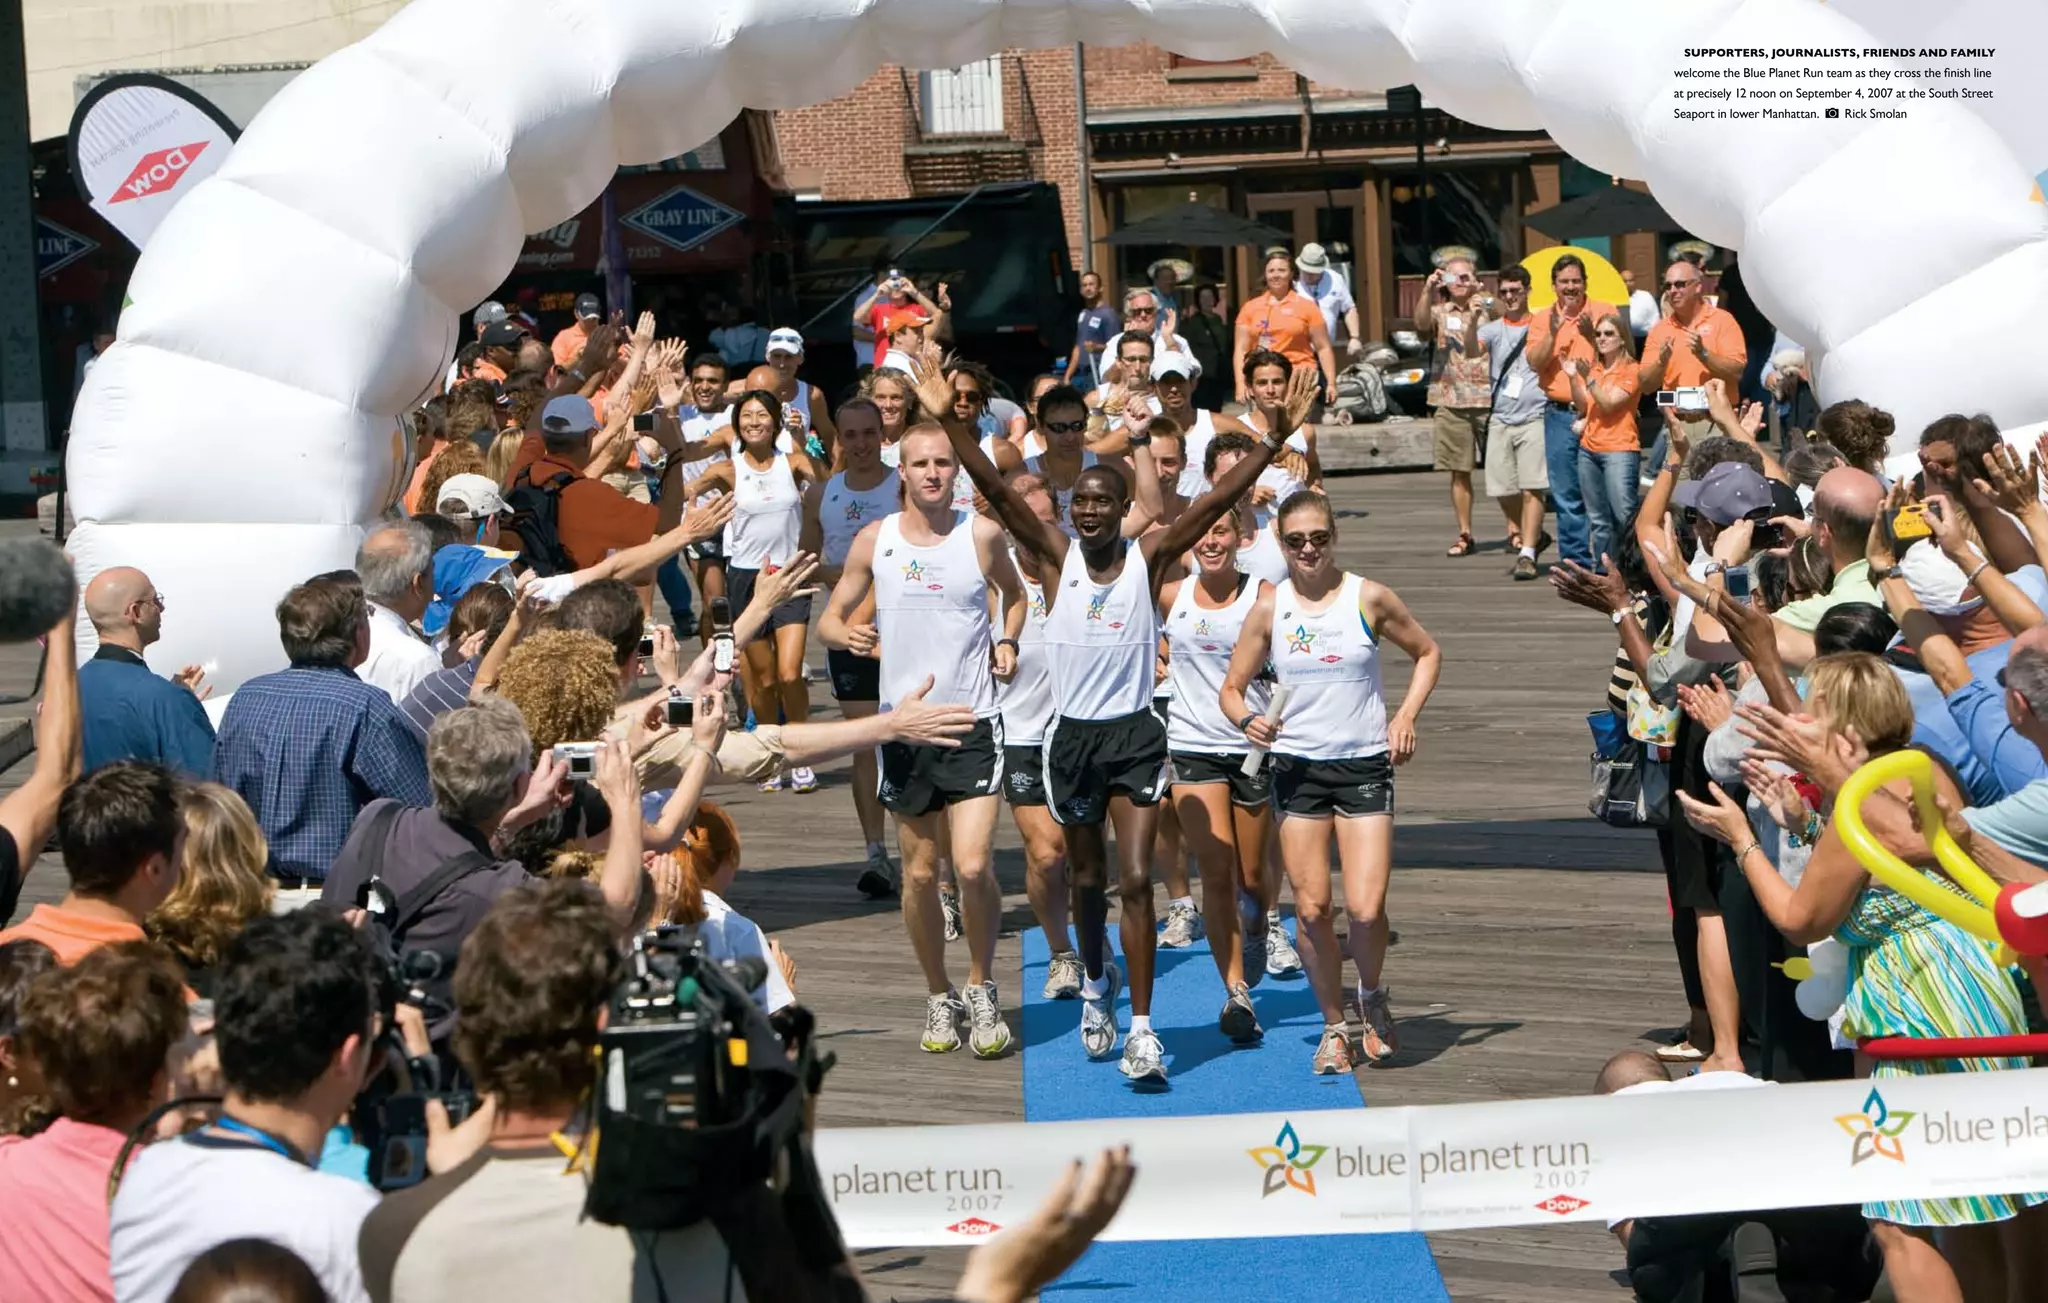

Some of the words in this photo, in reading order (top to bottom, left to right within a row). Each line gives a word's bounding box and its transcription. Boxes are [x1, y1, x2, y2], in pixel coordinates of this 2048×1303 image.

[642, 209, 684, 227] GRAY
[687, 208, 722, 225] LINE
[38, 237, 74, 255] LINE
[1923, 1110, 1995, 1145] blue
[1335, 1145, 1407, 1178] blue
[1419, 1141, 1524, 1183] planet
[1532, 1142, 1590, 1167] run
[833, 1164, 938, 1203] planet
[945, 1168, 1003, 1191] run
[1533, 1170, 1592, 1189] 2007
[946, 1195, 1004, 1212] 2007
